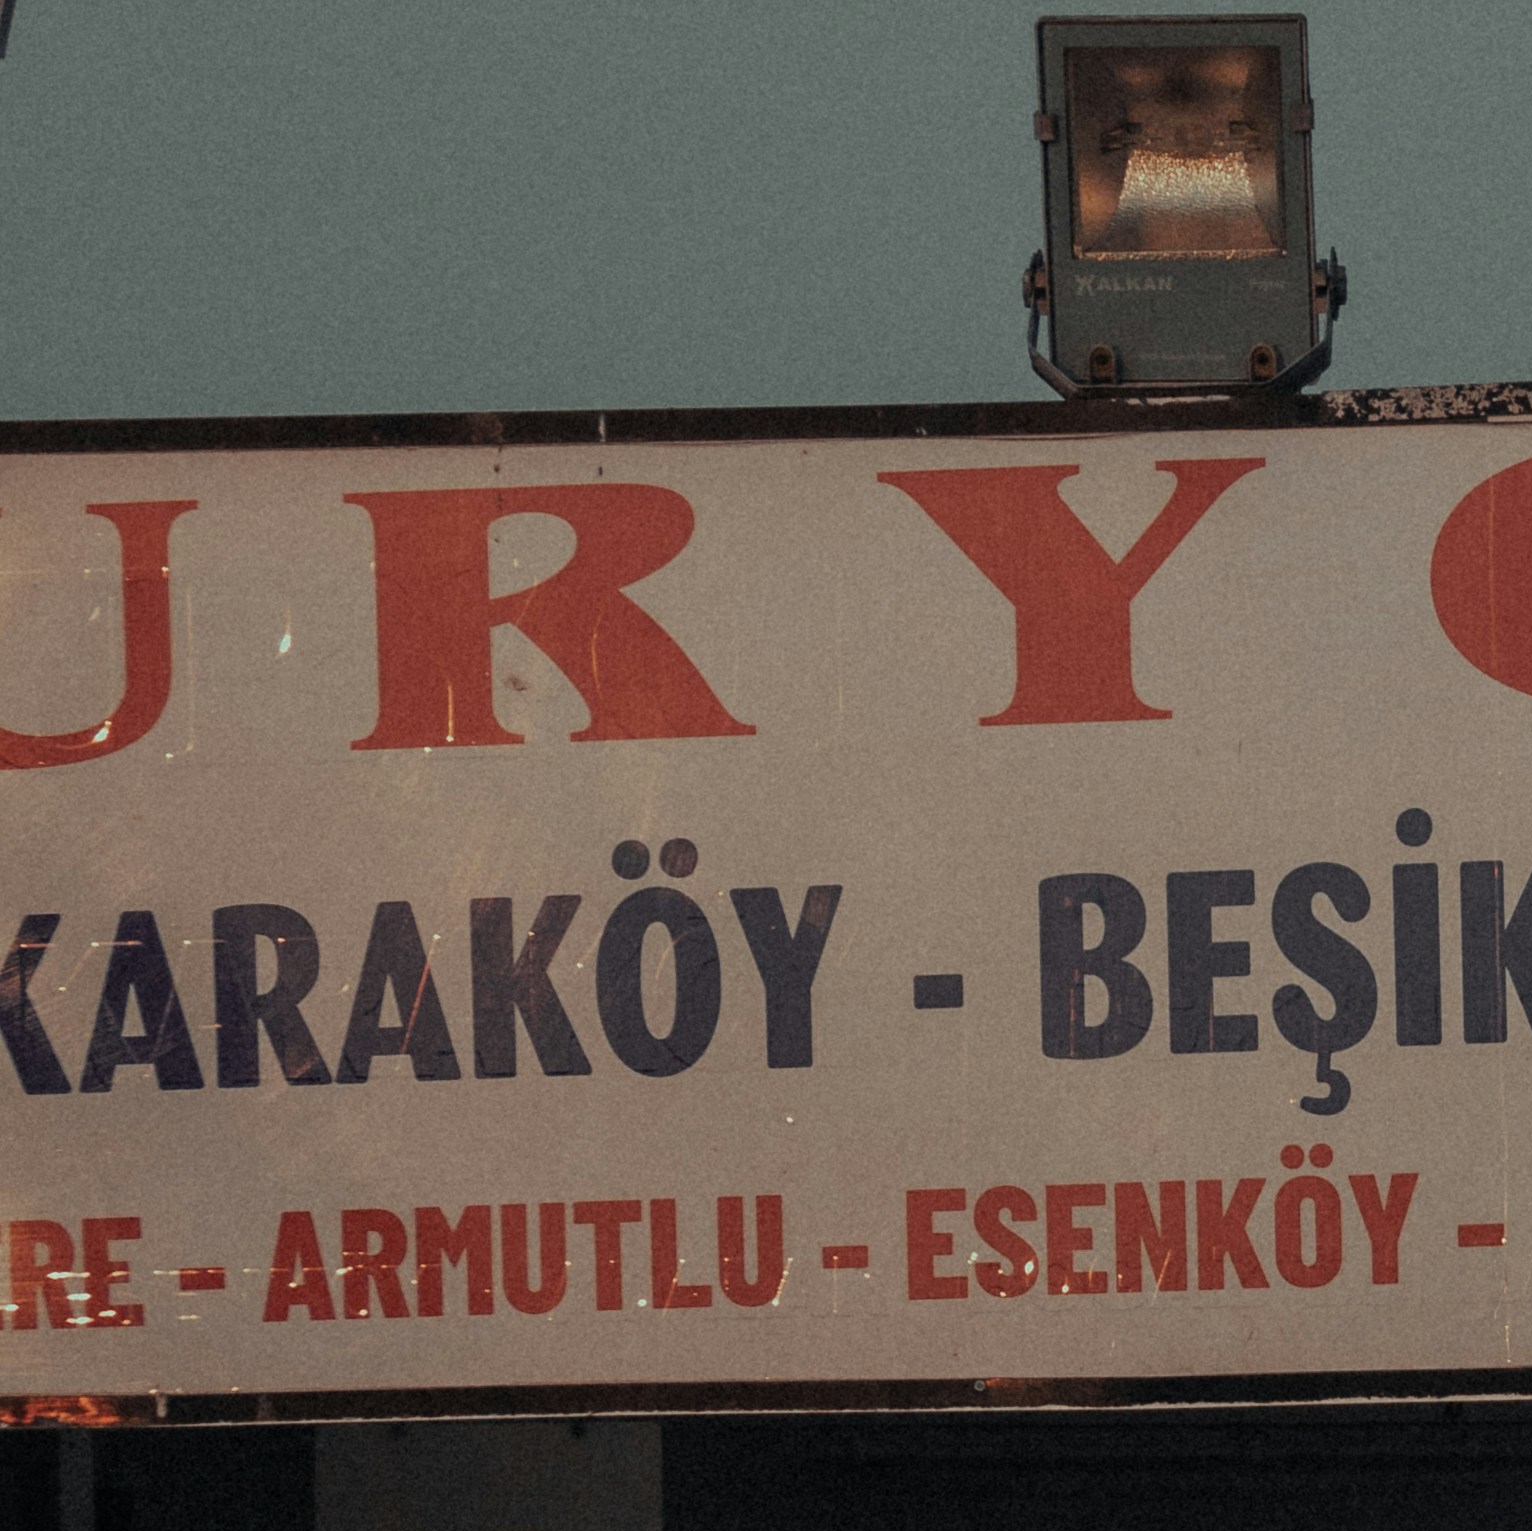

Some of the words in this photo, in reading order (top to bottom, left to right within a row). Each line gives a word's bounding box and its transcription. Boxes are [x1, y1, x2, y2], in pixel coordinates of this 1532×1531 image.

[0, 838, 842, 1096] KARAKÖY
[263, 1195, 785, 1323] ARMUTLU
[905, 1143, 1418, 1301] ESENKÖY
